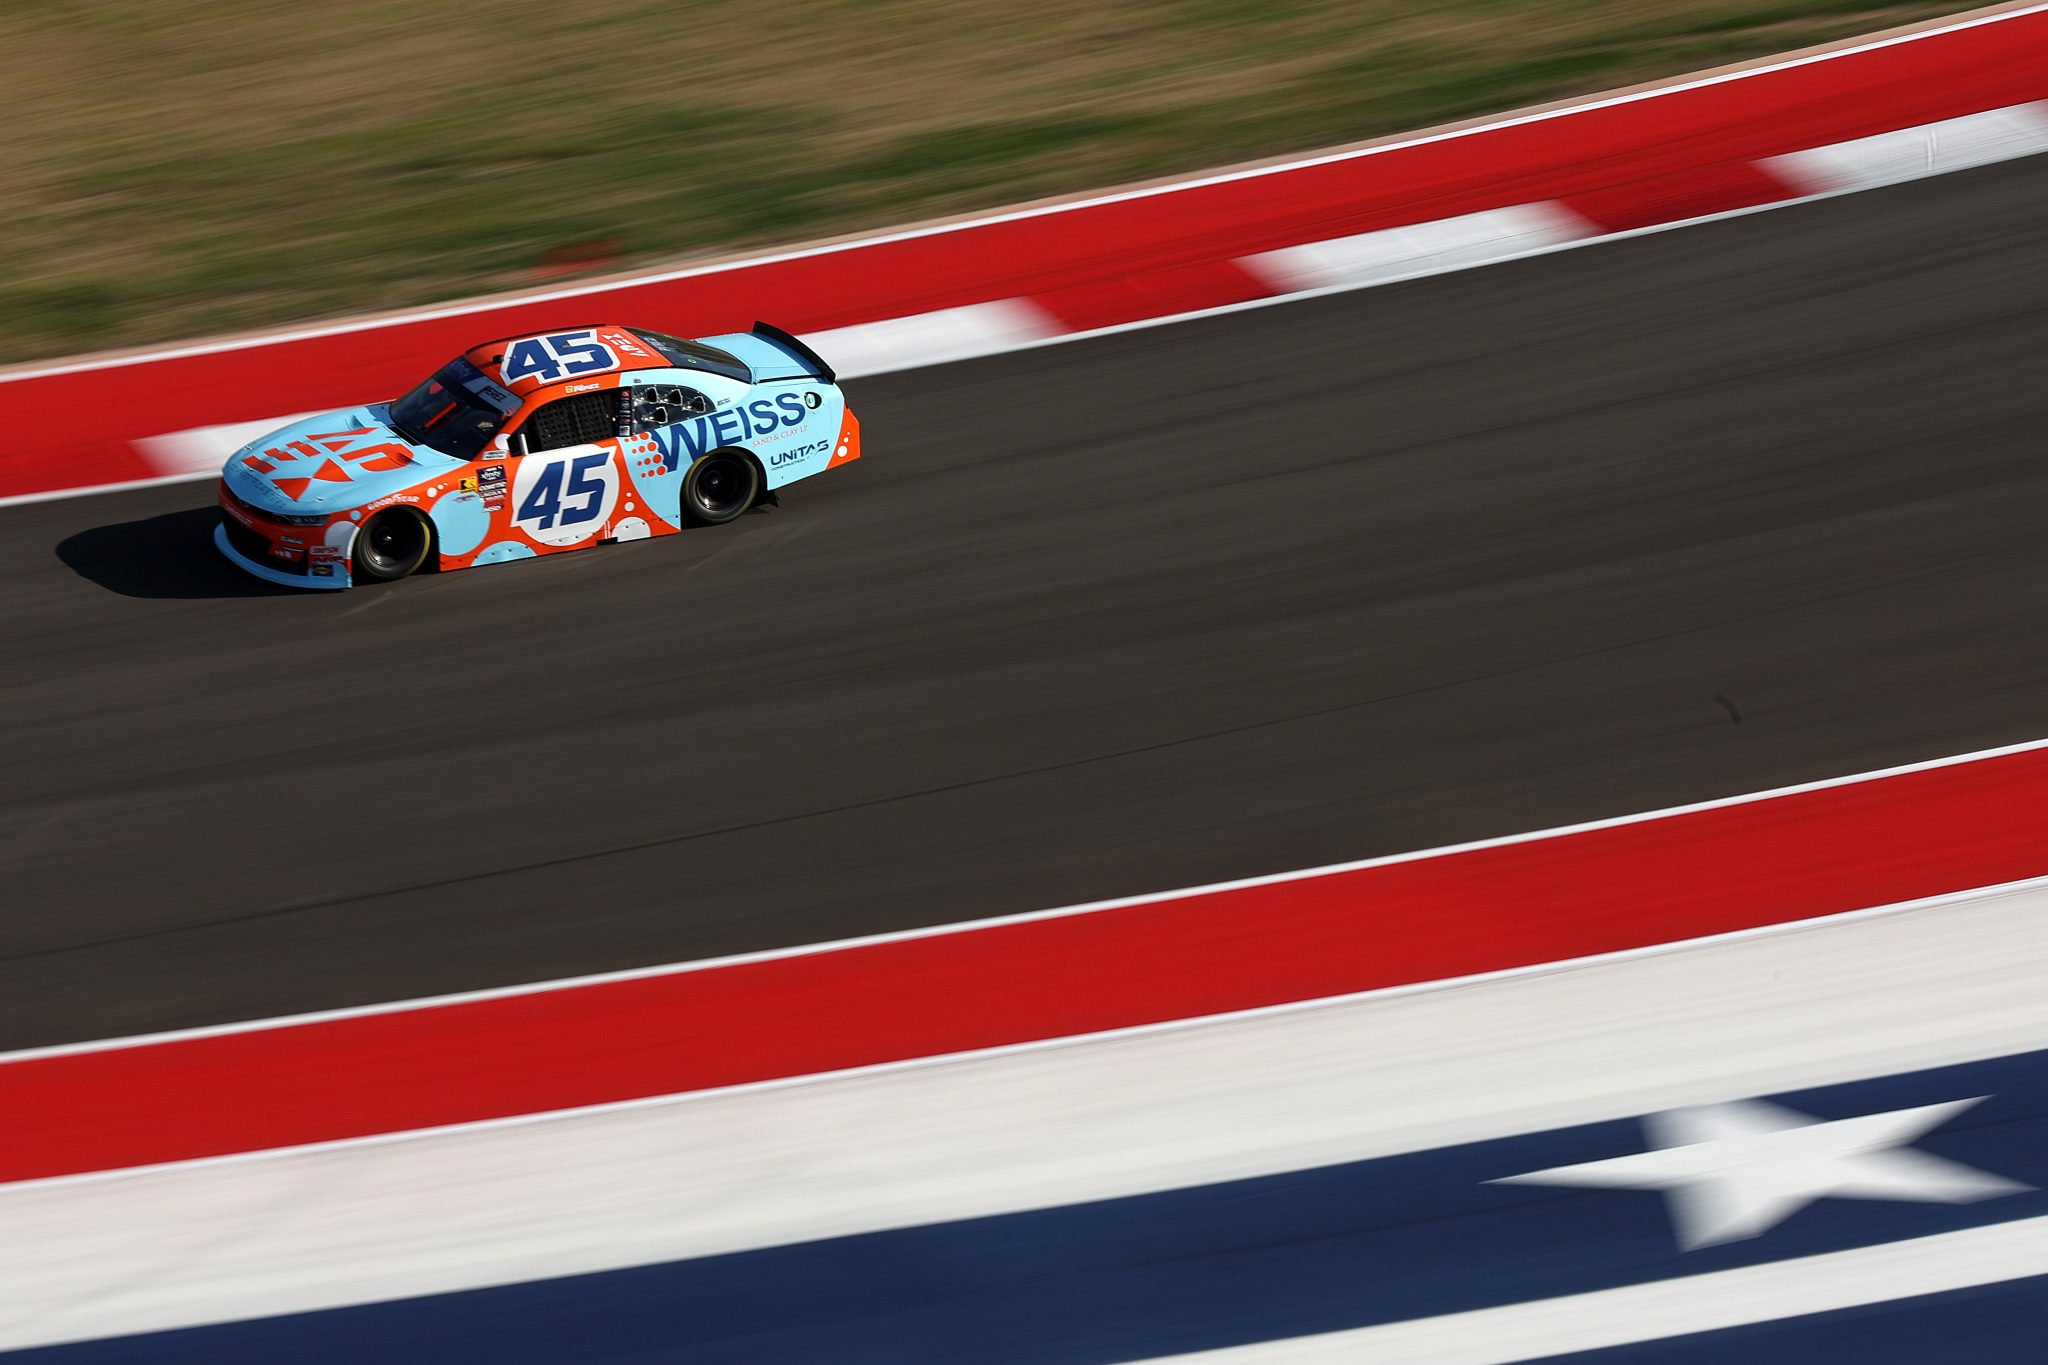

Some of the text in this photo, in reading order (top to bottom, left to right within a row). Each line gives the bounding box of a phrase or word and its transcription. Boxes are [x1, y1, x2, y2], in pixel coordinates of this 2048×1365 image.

[506, 331, 614, 380] 45
[651, 393, 806, 473] WEISS
[752, 436, 772, 448] SAND
[781, 428, 798, 439] CLAY
[367, 493, 420, 510] GOODYEAR
[516, 451, 610, 530] 45
